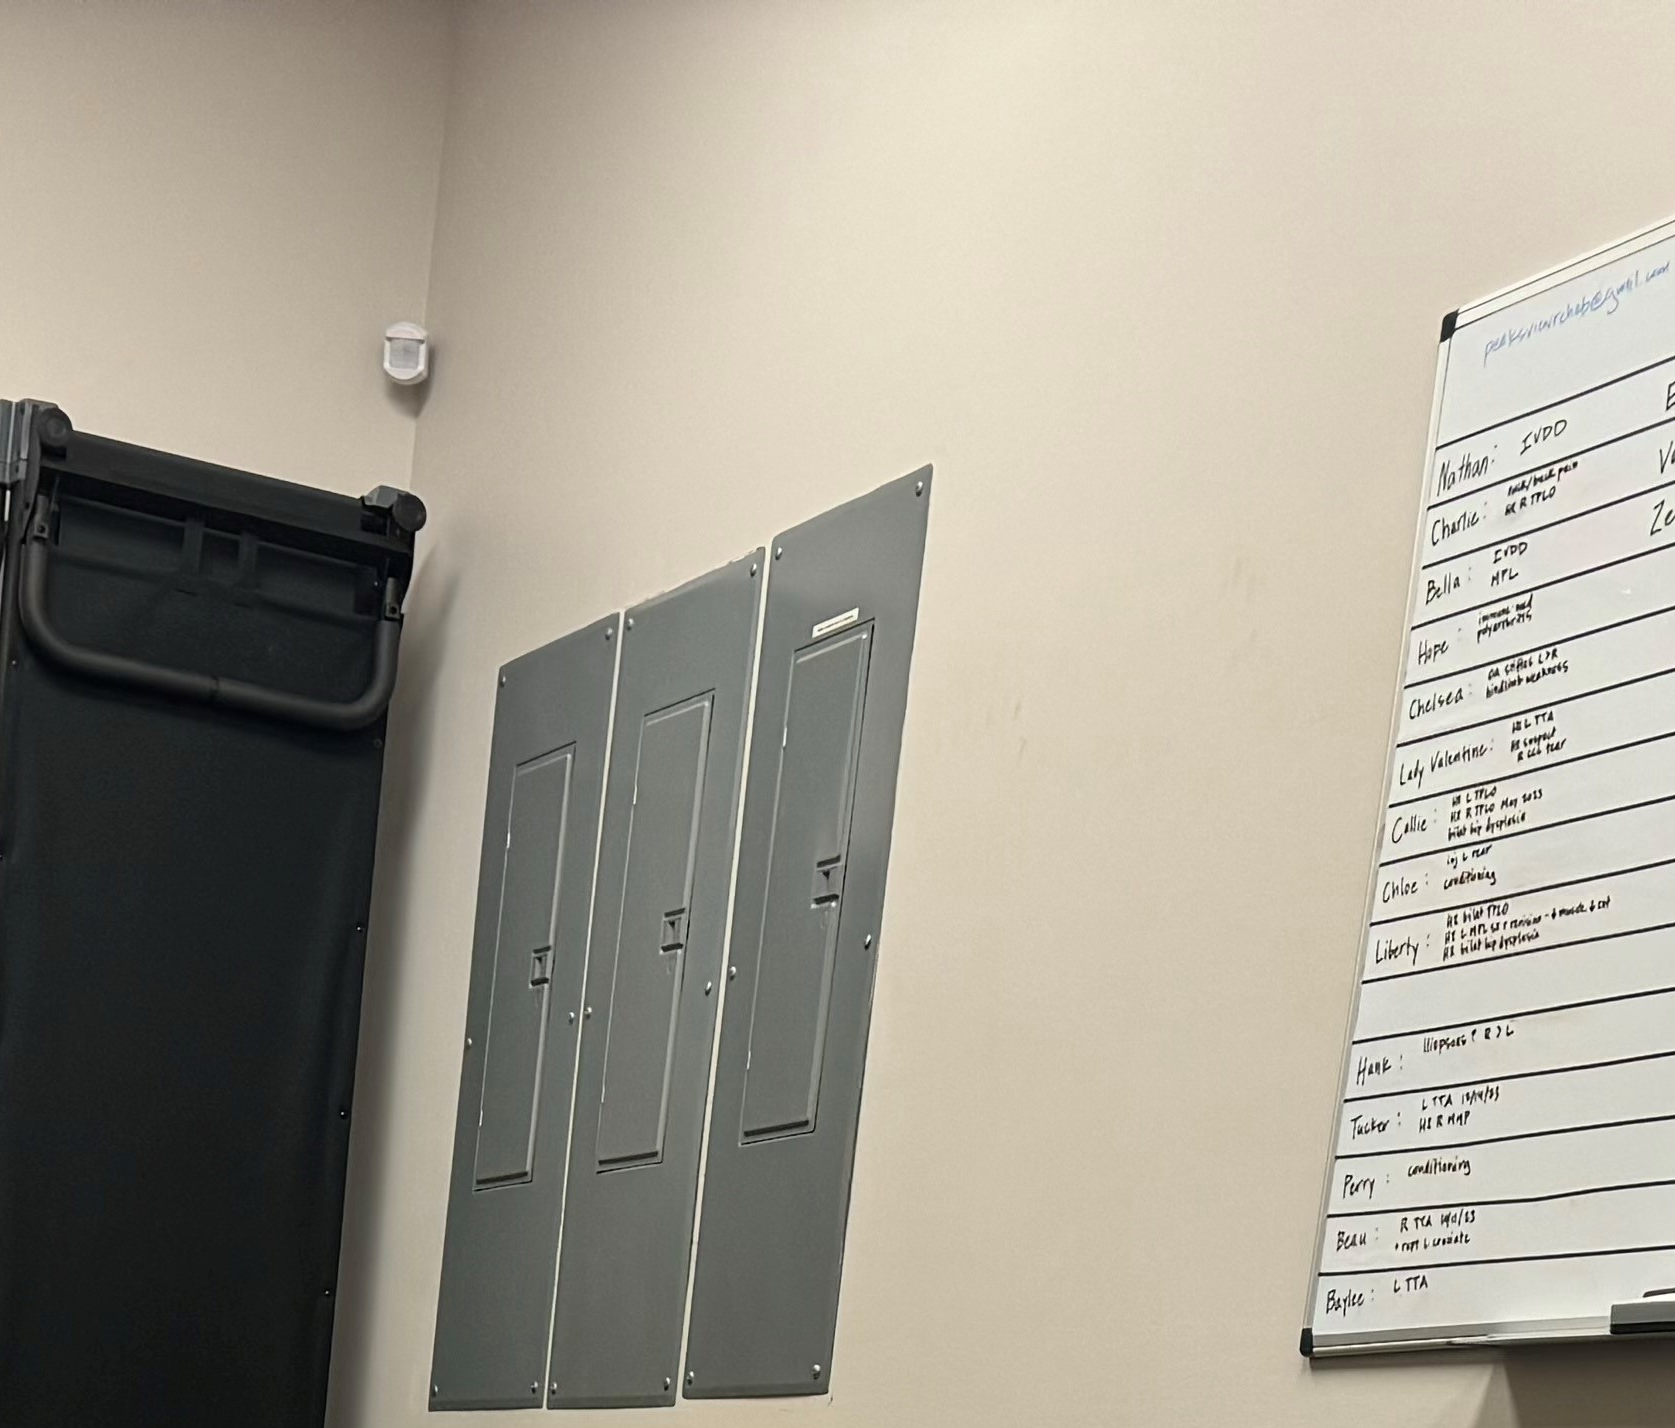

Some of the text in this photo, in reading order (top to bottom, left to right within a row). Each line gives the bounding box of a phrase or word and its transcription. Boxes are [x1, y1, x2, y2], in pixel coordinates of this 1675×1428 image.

[1520, 419, 1567, 456] IVDD
[1530, 485, 1556, 506] TPLO
[1492, 541, 1529, 564] IVDD
[1490, 567, 1520, 587] MPL
[1525, 660, 1569, 684] weakness
[1399, 760, 1424, 788] Lady
[1474, 785, 1497, 801] TPLO
[1474, 802, 1495, 817] TPLO
[1443, 865, 1497, 891] conditioning
[1432, 1093, 1453, 1108] TTA
[1436, 1114, 1443, 1128] R
[1407, 1156, 1472, 1177] conditioning
[1400, 1216, 1409, 1234] R
[1393, 1279, 1401, 1293] L
[1406, 1274, 1429, 1292] TTA
